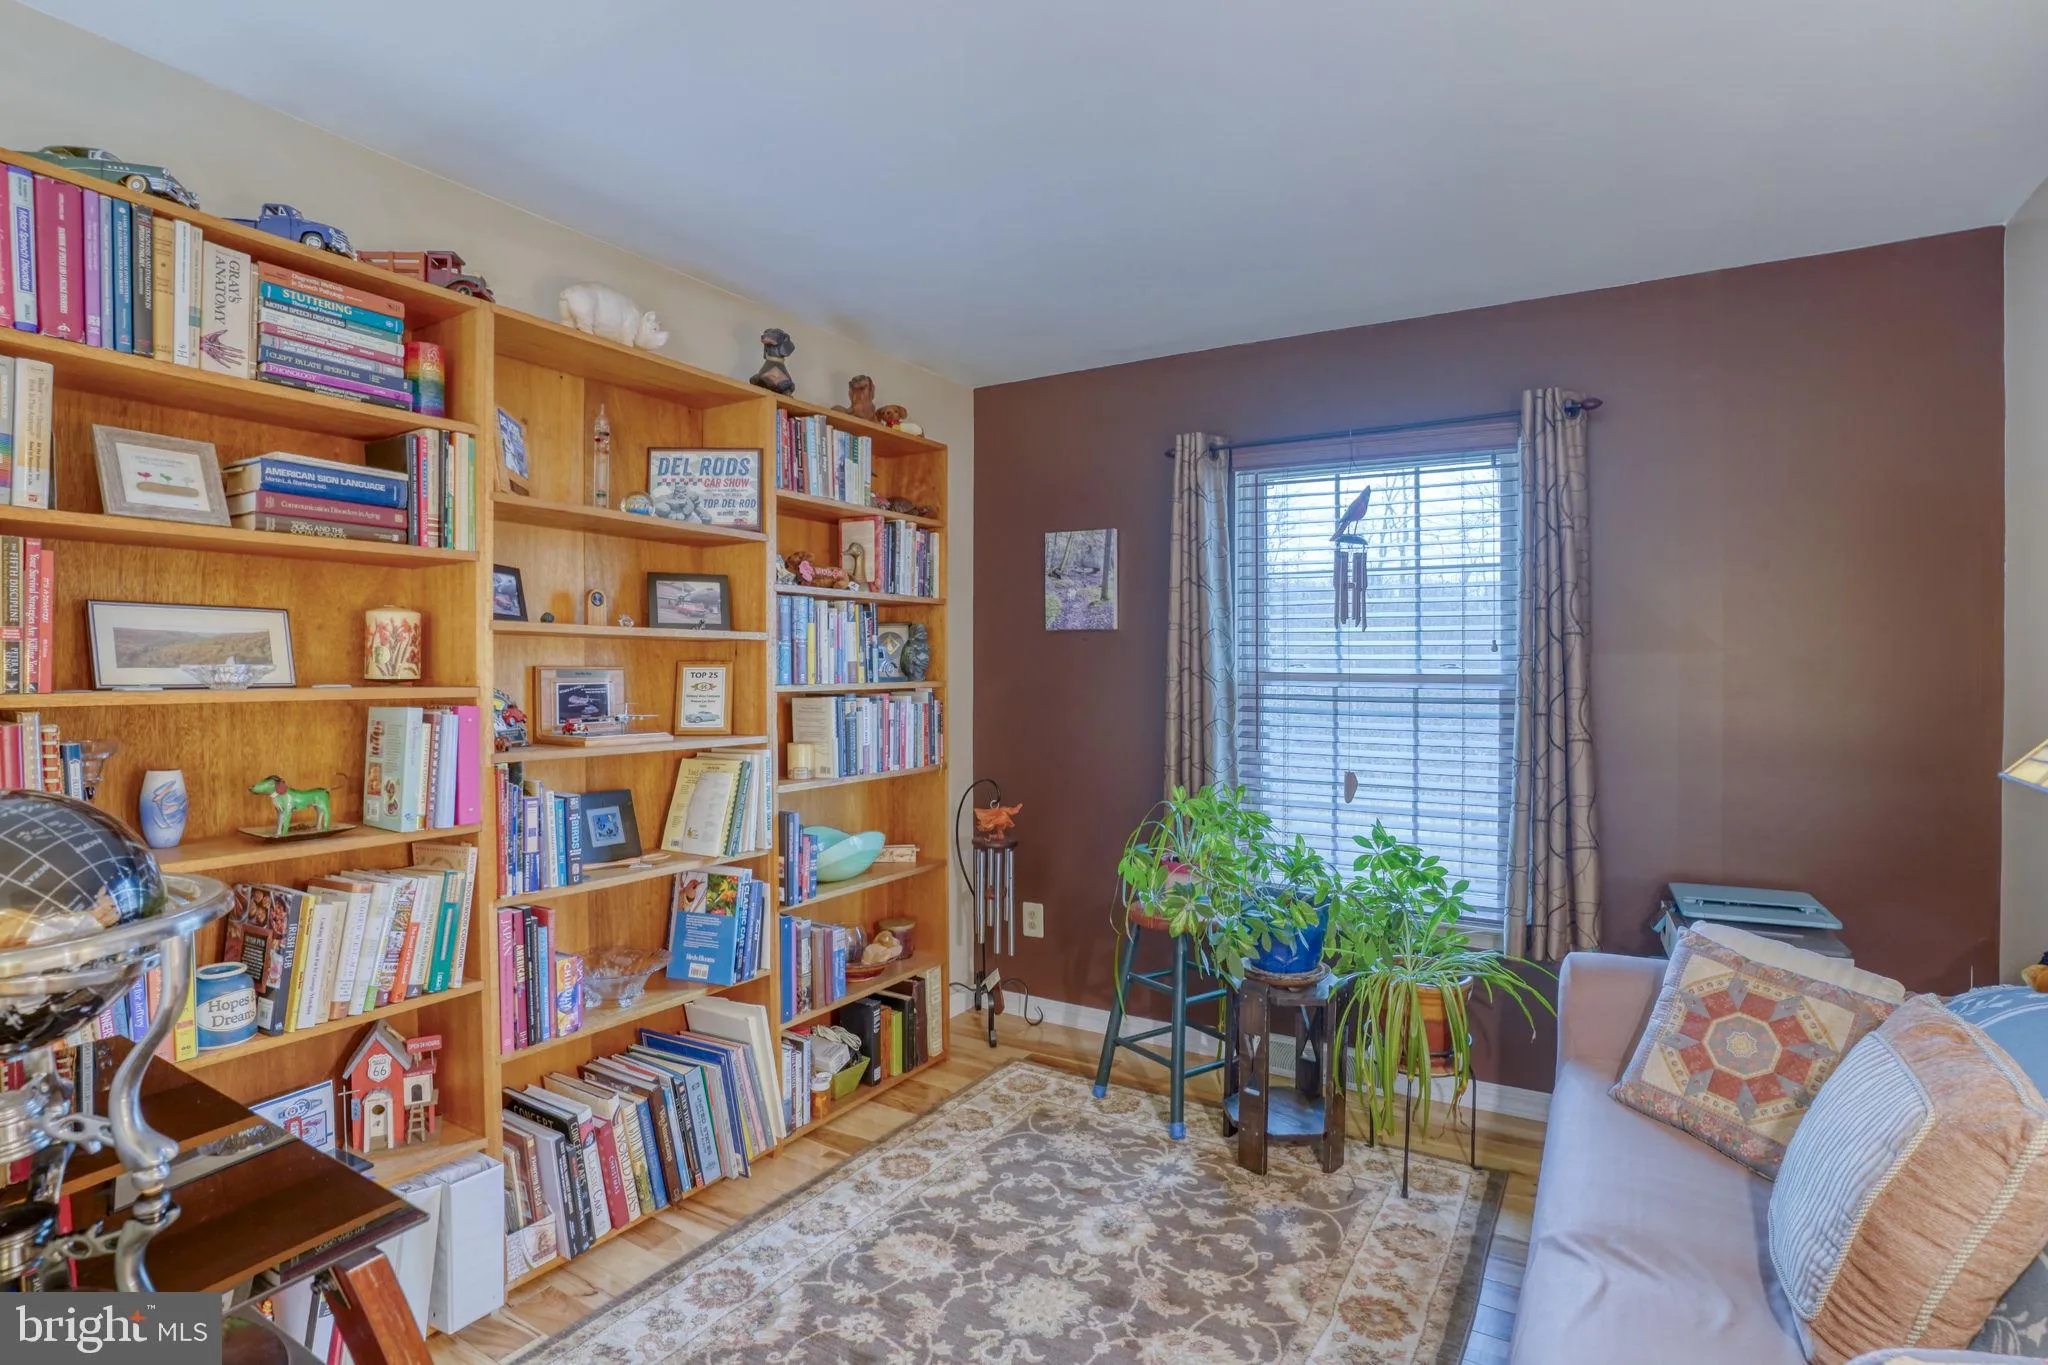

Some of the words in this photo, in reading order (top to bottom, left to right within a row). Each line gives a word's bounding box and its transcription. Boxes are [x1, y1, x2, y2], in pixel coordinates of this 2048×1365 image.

[18, 209, 29, 230] Motor
[19, 231, 31, 257] Speech
[20, 259, 32, 290] Disorders
[215, 256, 226, 325] ANATOMY
[283, 289, 352, 315] STUTTERING
[265, 301, 288, 311] MOTOR
[289, 306, 312, 318] SPEECH
[313, 312, 346, 327] DISORDERS
[269, 353, 293, 364] CLEFT
[294, 357, 322, 370] PALATE
[269, 365, 316, 381] PHONOLOGY
[265, 467, 316, 482] AMERICAN
[317, 474, 339, 485] SIGN
[340, 477, 386, 491] LANGUAGE
[658, 457, 692, 476] DEL
[700, 457, 751, 476] RODS
[704, 478, 722, 488] CAR
[723, 478, 749, 487] SHOW
[280, 501, 329, 513] Communication
[330, 506, 358, 518] Disorders
[703, 499, 720, 508] TOP
[721, 499, 737, 508] DEL
[739, 499, 756, 507] ROD
[9, 552, 19, 577] FIFTH
[29, 553, 39, 567] Your
[29, 569, 39, 594] Survival
[9, 579, 18, 622] DISCIPLINE
[27, 595, 39, 624] Strategies
[28, 625, 37, 636] Are
[27, 638, 37, 659] Killing
[571, 820, 580, 849] BIRDS
[461, 881, 473, 927] MOOSEWOOD
[741, 884, 750, 929] CLASSIC
[287, 923, 297, 949] IRISH
[456, 928, 467, 968] COOKBOOK
[501, 919, 513, 957] JAPAN
[283, 950, 294, 969] PUB
[515, 944, 525, 983] AMERICAN
[134, 988, 144, 1000] for
[208, 995, 249, 1013] Hopes
[133, 1001, 146, 1027] Jeffrey
[373, 1066, 387, 1077] 66
[513, 1105, 554, 1129] CONCEPT
[682, 1110, 692, 1131] YORK
[696, 1093, 707, 1124] UNITED
[701, 1125, 713, 1156] STATES
[569, 1122, 583, 1160] CONCEPT
[576, 1163, 586, 1186] CARS
[614, 1130, 633, 1178] WORLD
[605, 1154, 623, 1194] CHRISTMAS
[623, 1177, 641, 1213] ATLAS
